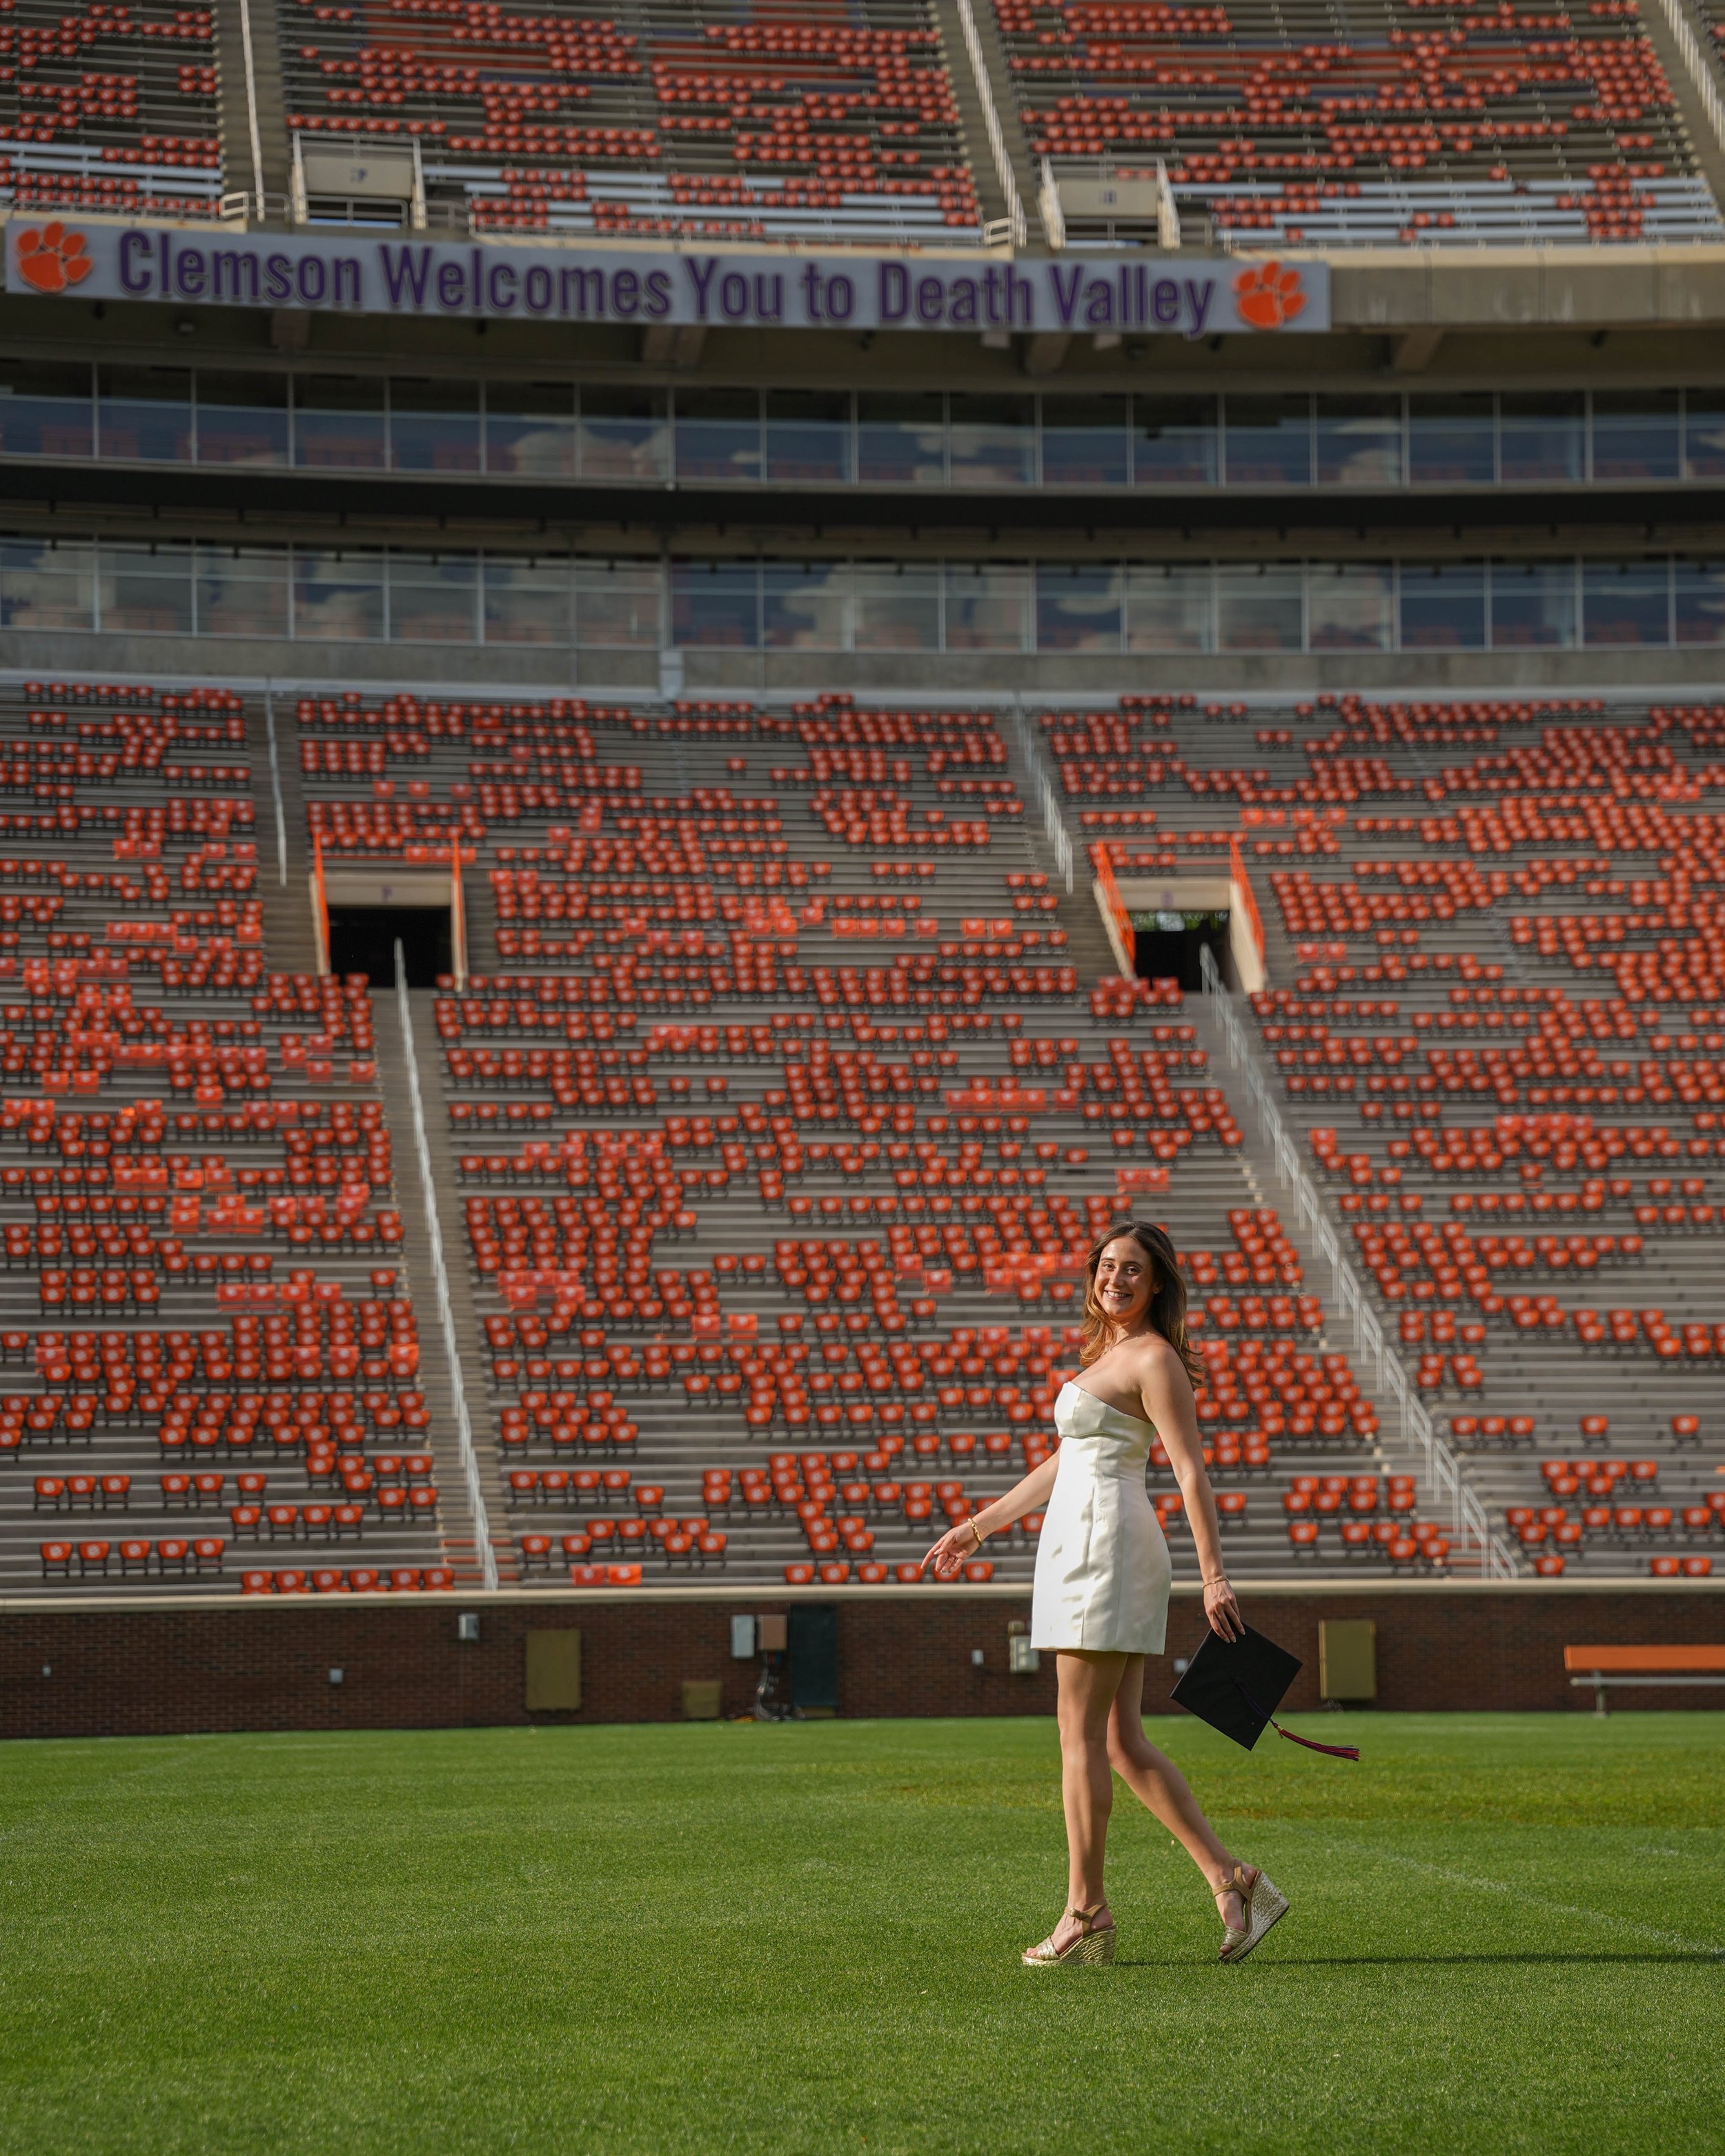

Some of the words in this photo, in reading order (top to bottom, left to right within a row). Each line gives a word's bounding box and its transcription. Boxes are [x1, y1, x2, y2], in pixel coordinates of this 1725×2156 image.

[119, 230, 362, 301] Clemson
[377, 244, 672, 316] Welcomes
[684, 257, 785, 319] You
[800, 262, 855, 321] to
[877, 260, 1034, 323] Death
[1047, 264, 1214, 337] Valley
